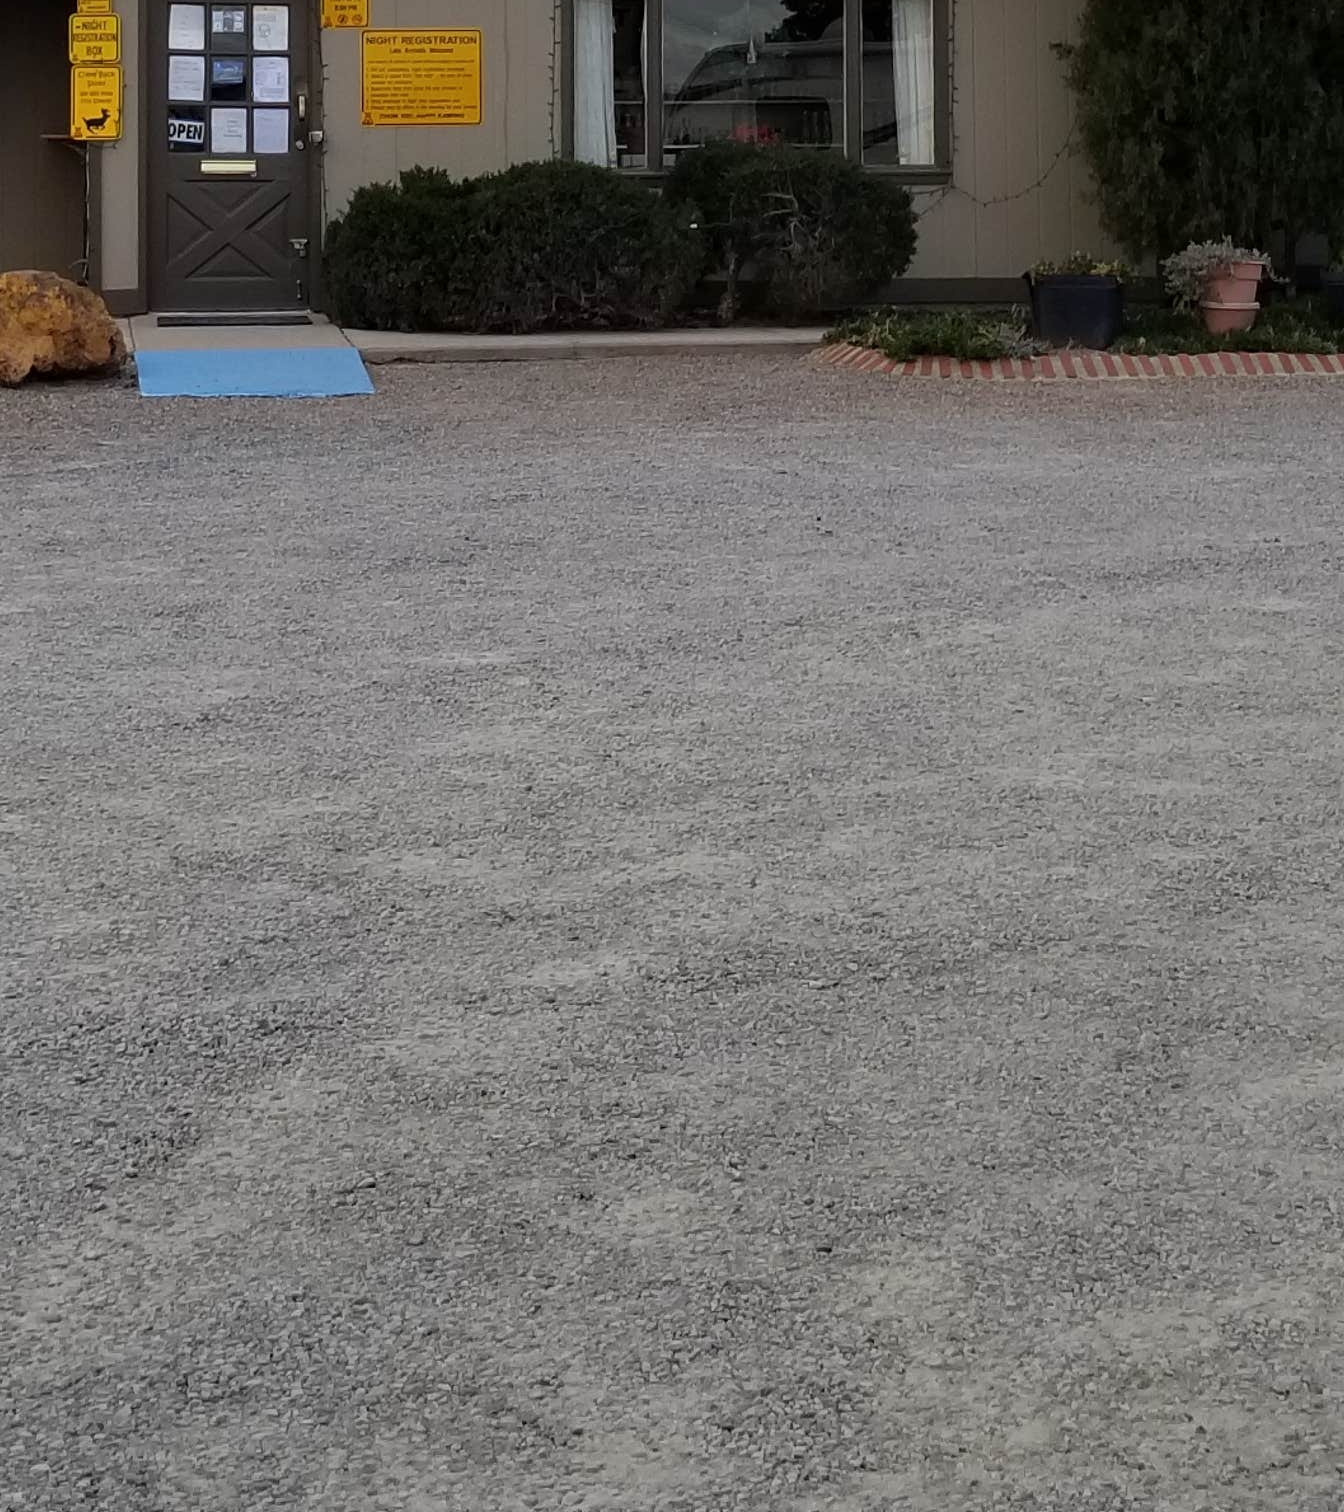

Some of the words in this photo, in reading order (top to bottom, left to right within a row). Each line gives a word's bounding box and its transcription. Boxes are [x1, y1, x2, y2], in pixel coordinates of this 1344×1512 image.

[81, 20, 107, 31] NIGHT
[366, 36, 397, 45] NIGHT
[400, 36, 477, 45] REGISTRATION
[86, 46, 103, 56] BOX
[168, 123, 203, 141] OPEN
